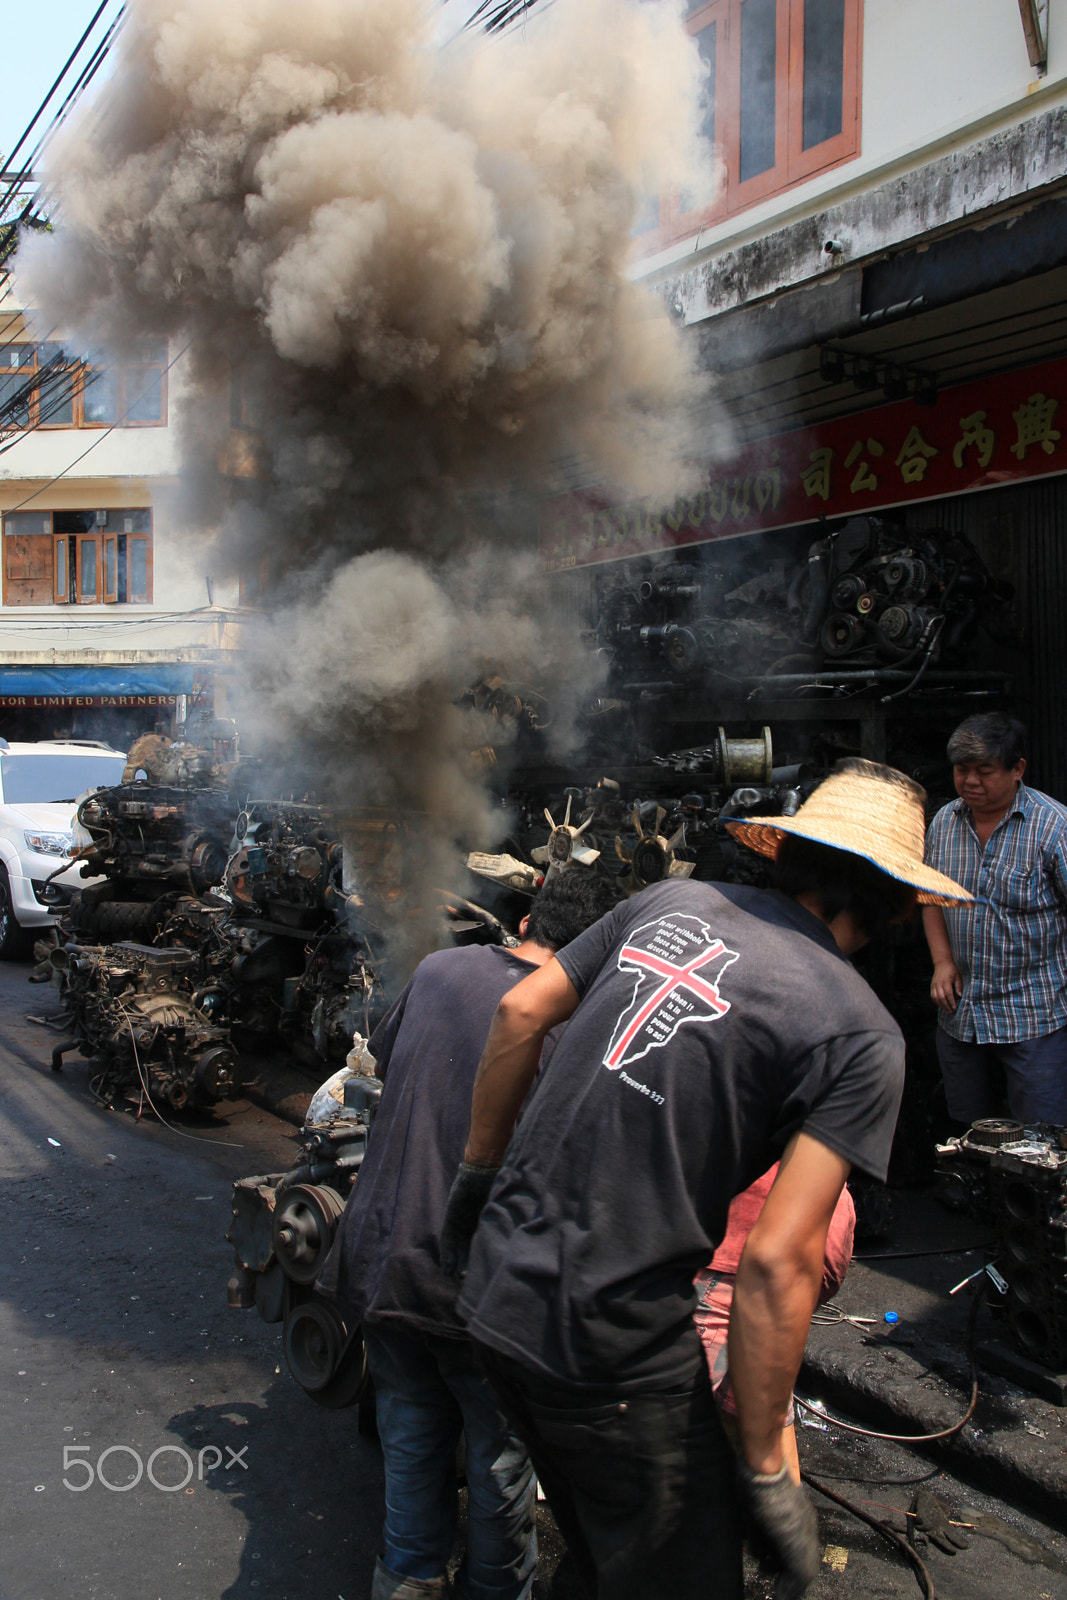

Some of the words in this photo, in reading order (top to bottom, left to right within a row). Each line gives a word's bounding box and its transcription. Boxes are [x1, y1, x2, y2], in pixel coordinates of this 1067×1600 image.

[0, 696, 26, 706] TOR
[34, 696, 94, 706] LIMITED
[656, 928, 673, 937] good
[671, 934, 688, 946] from
[674, 926, 704, 944] withhold
[646, 942, 669, 956] deserve
[653, 935, 670, 947] those
[669, 944, 683, 954] who
[666, 1001, 674, 1009] is
[672, 1005, 680, 1014] in
[669, 990, 687, 1006] When
[686, 1002, 694, 1011] it
[657, 1009, 675, 1022] your
[645, 1024, 653, 1033] to
[652, 1030, 665, 1041] act
[650, 1016, 672, 1033] power
[618, 1071, 650, 1095] Proverbs
